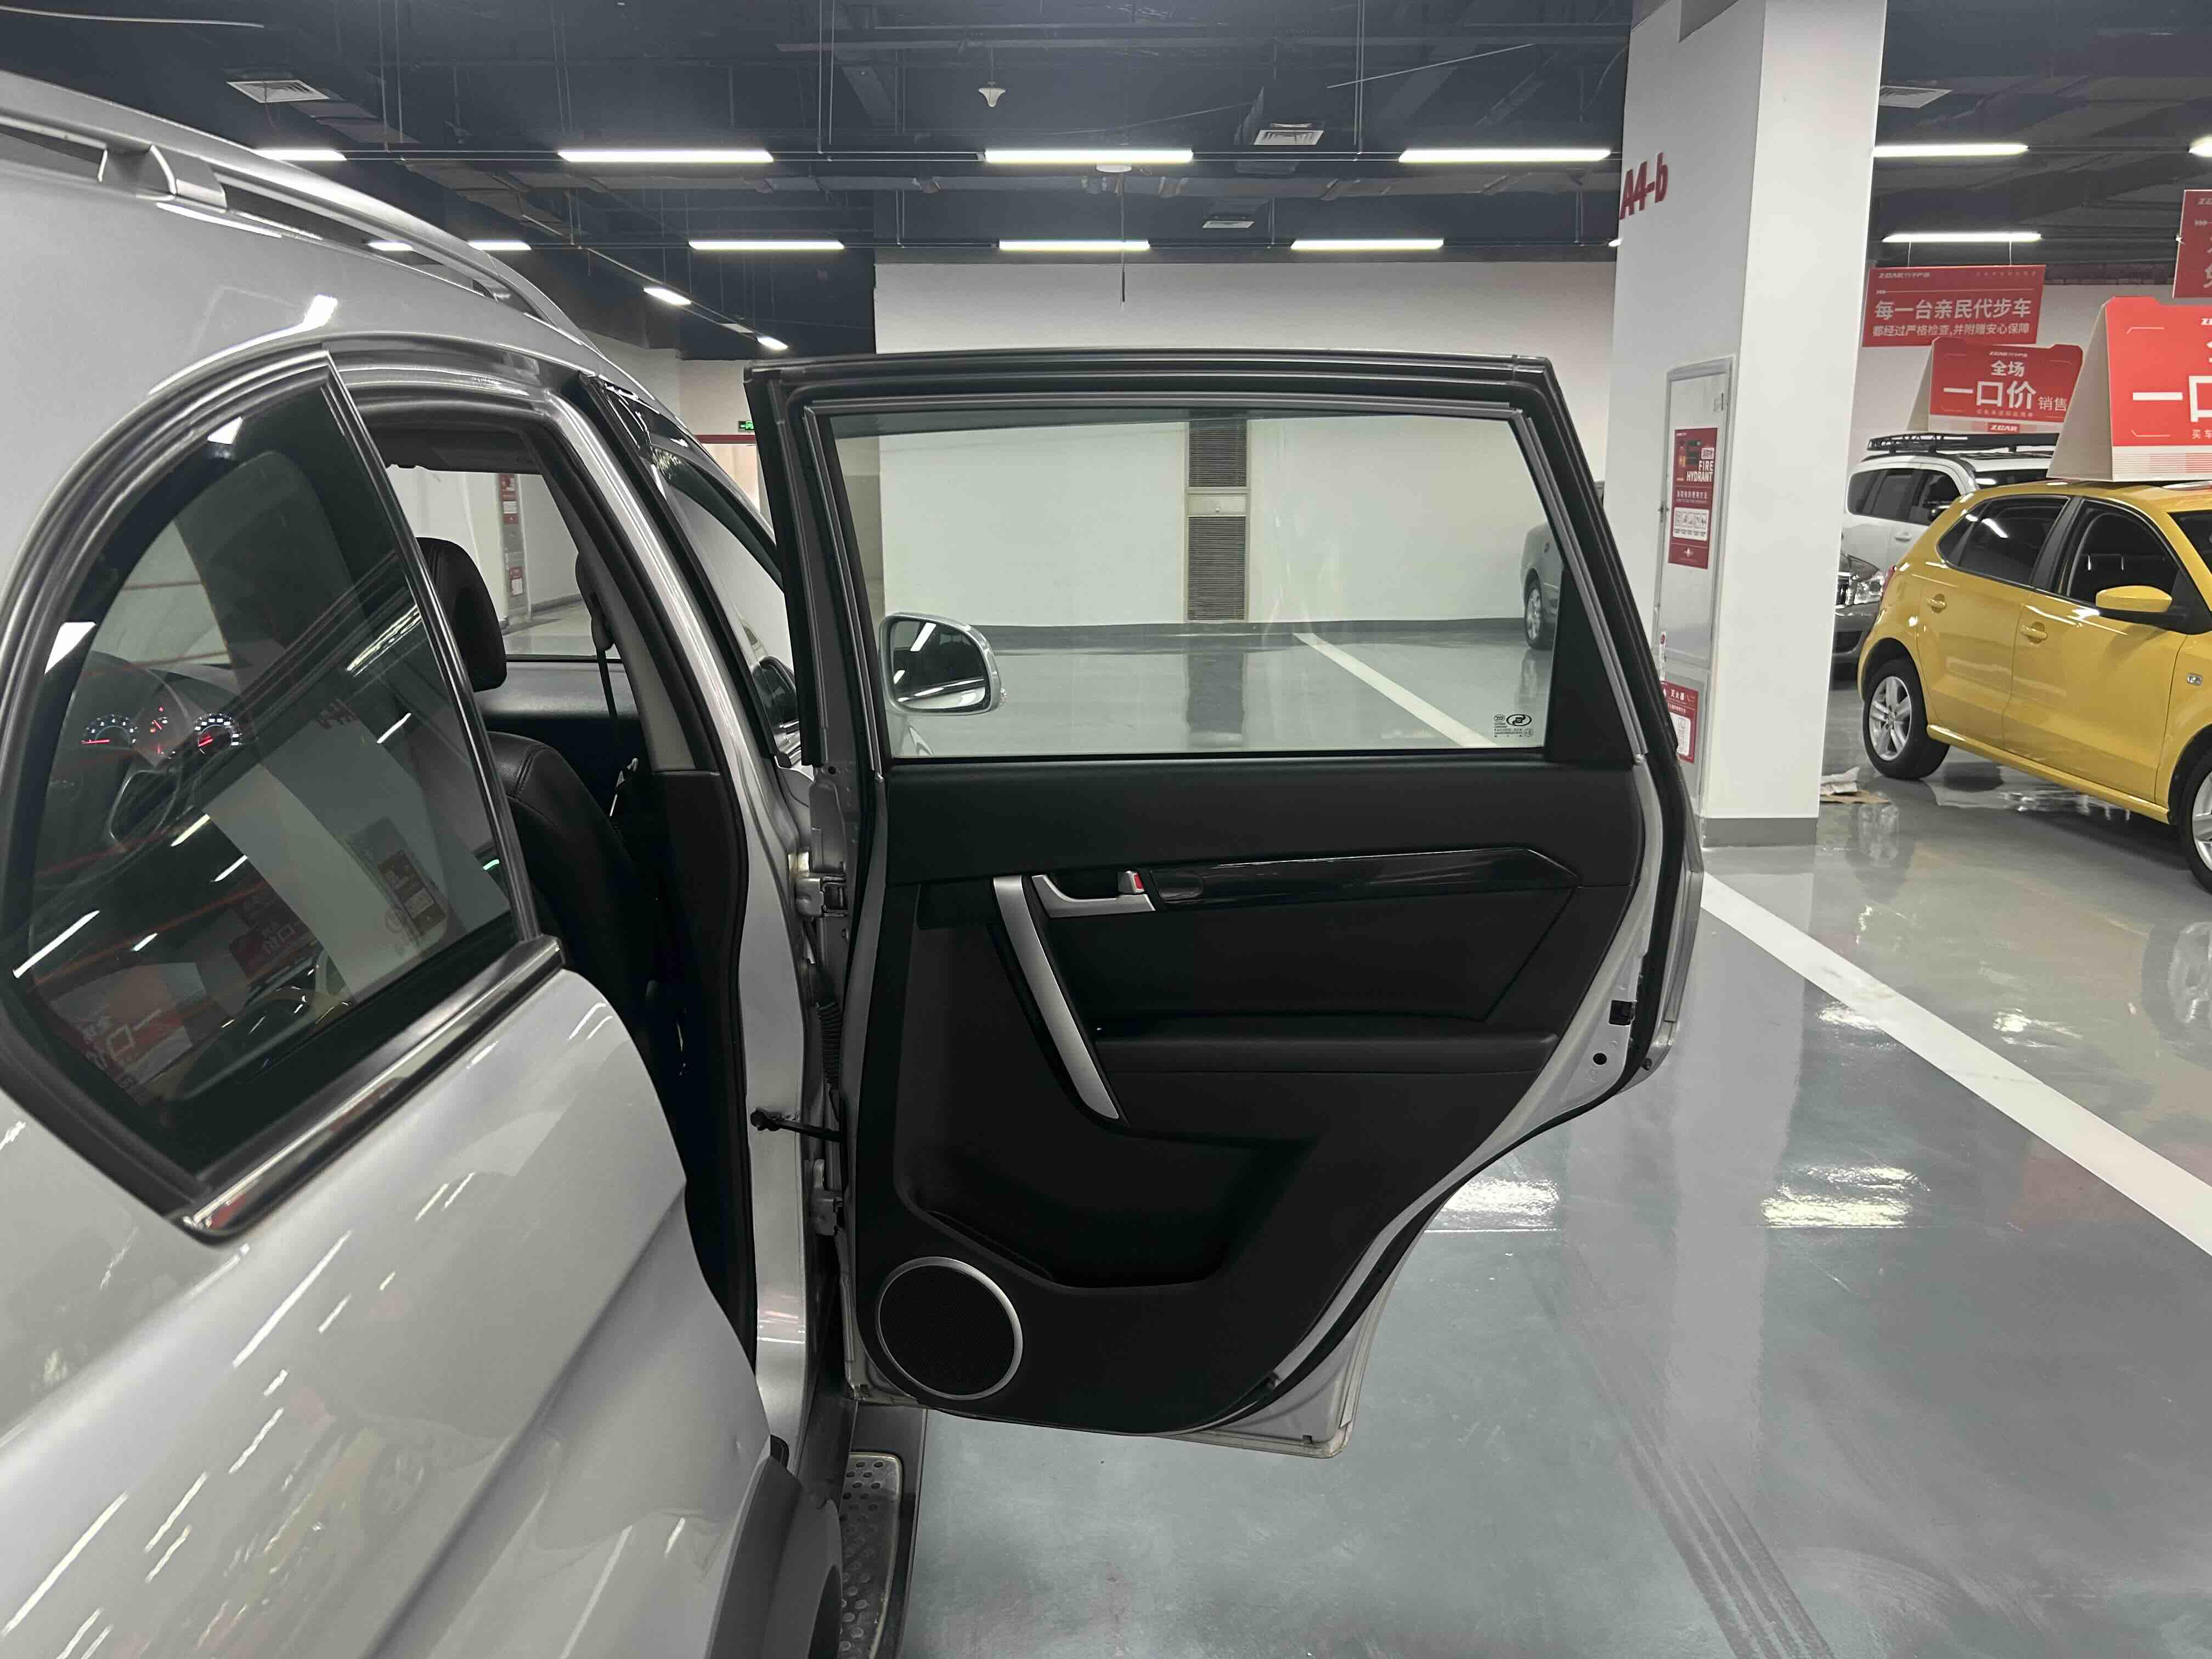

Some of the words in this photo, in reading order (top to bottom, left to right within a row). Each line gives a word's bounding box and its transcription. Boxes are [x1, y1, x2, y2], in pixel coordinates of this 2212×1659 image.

[1875, 298, 2032, 320] 每一台亲民代步车
[1991, 360, 2025, 377] 全场
[1943, 380, 2036, 409] 一口价
[2038, 396, 2068, 412] 销售
[1699, 460, 1714, 471] FIRE
[1686, 471, 1713, 482] HYDRANT
